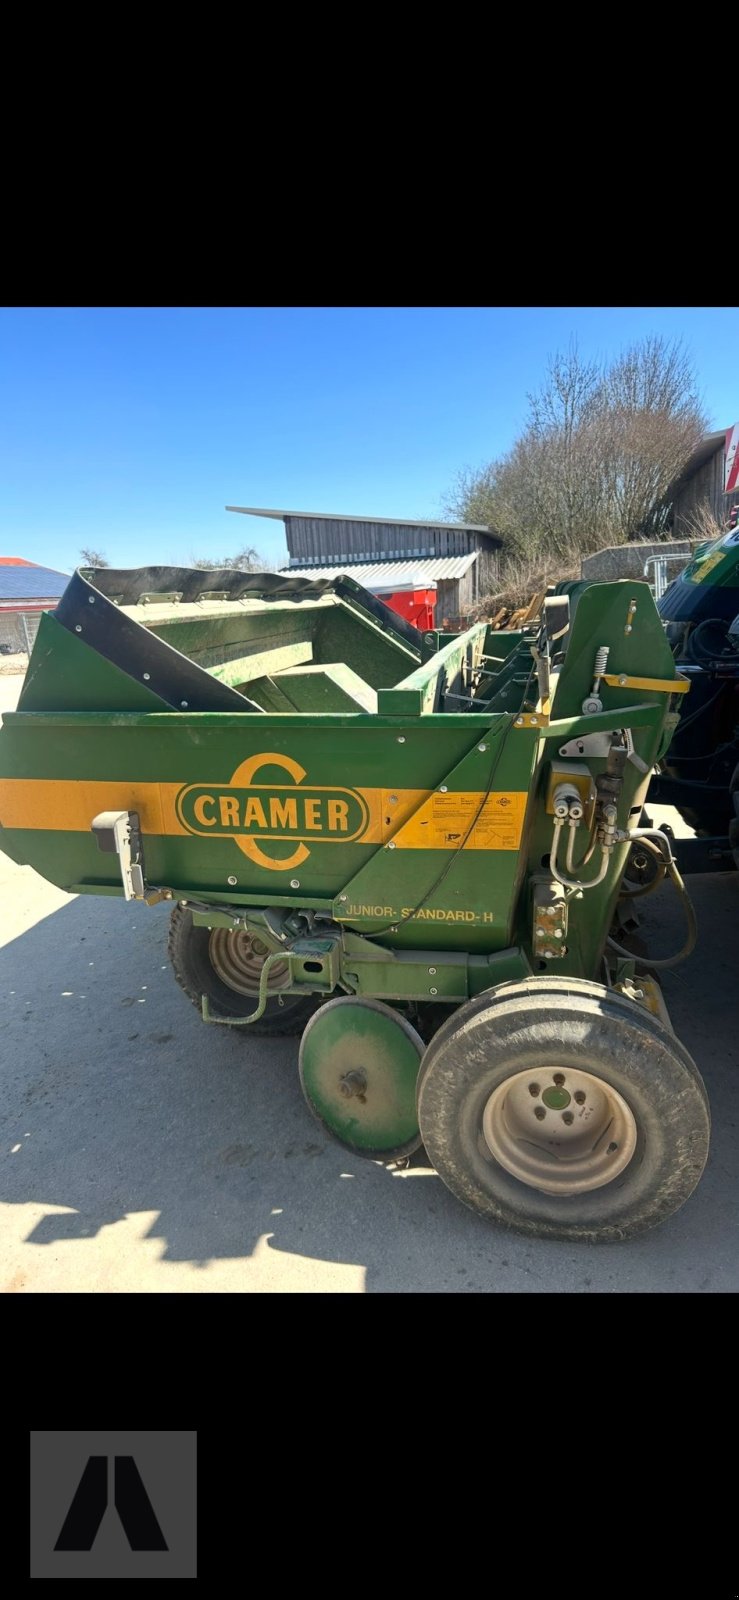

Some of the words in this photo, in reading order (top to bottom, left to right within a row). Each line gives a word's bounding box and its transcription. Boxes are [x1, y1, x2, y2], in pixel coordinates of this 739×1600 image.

[193, 794, 350, 831] CRAMER
[346, 904, 397, 917] JUNIOR-
[483, 912, 493, 922] H
